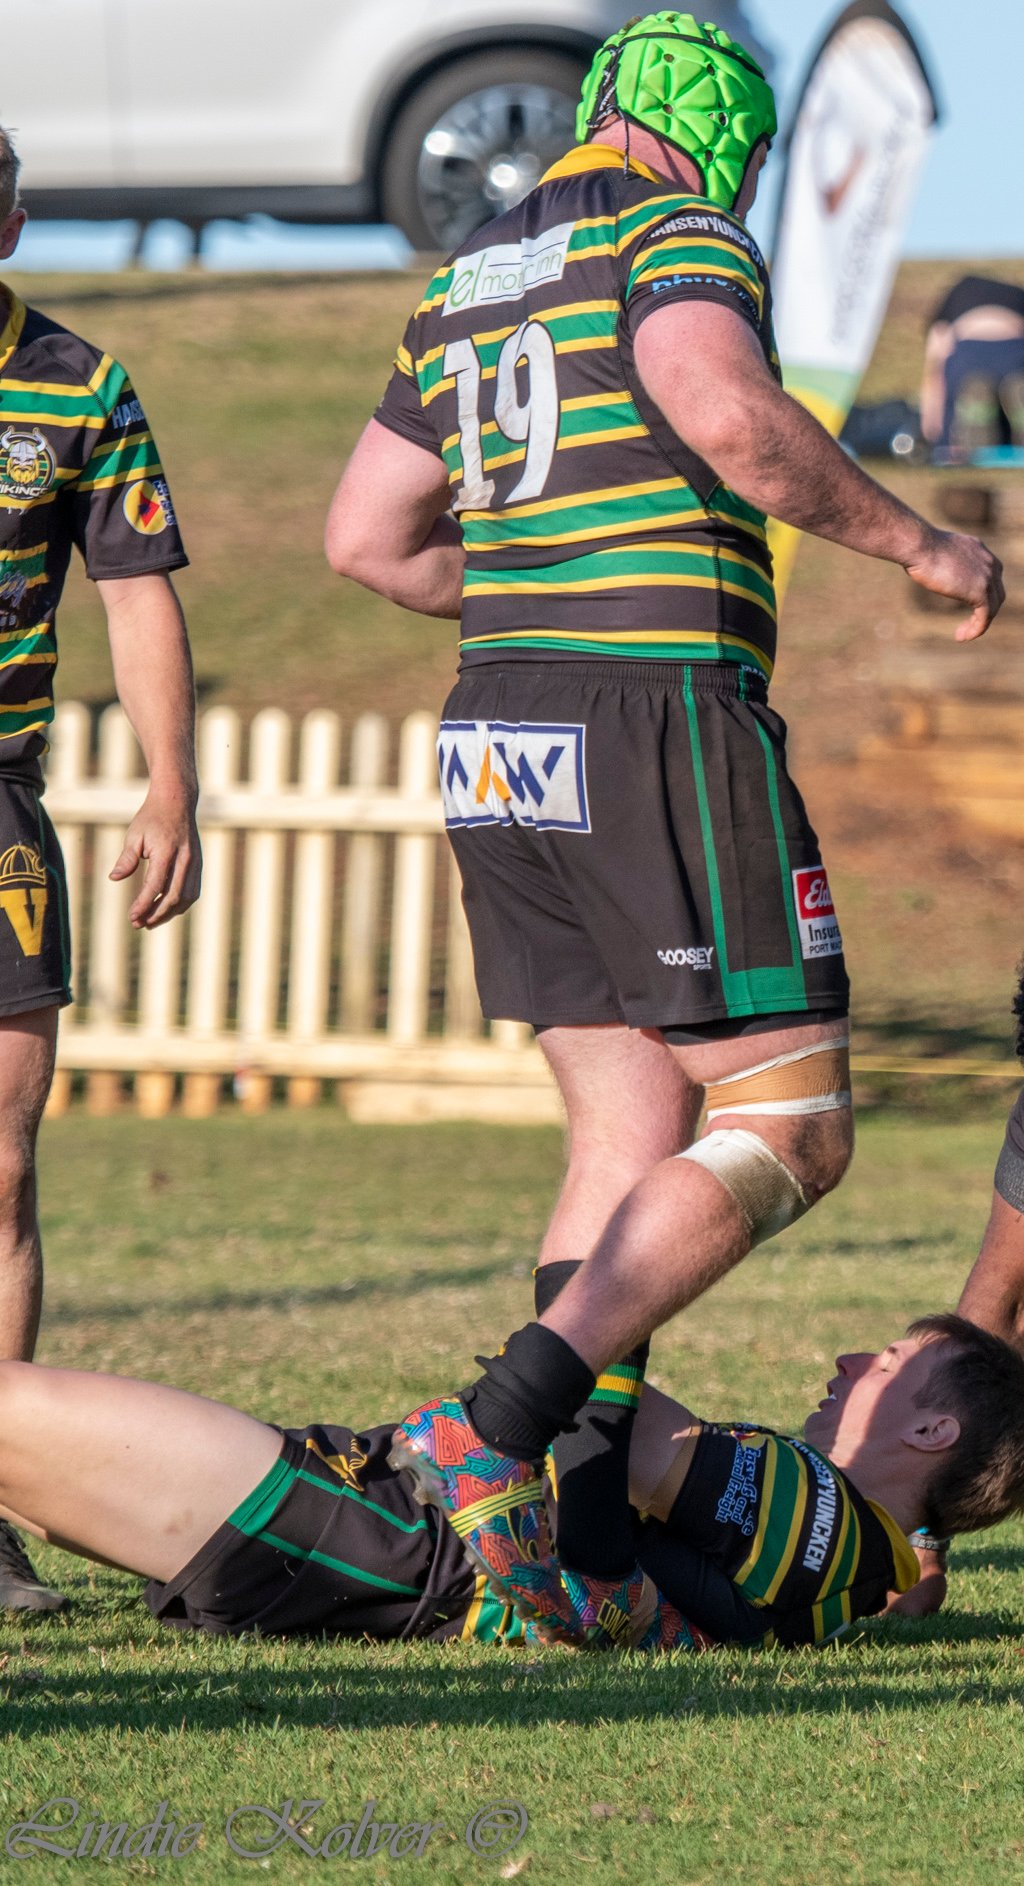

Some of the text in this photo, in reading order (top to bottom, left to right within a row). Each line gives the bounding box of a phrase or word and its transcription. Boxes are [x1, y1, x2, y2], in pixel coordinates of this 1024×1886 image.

[450, 251, 562, 307] el motr inn
[442, 321, 559, 512] 19
[715, 1478, 742, 1523] Freight
